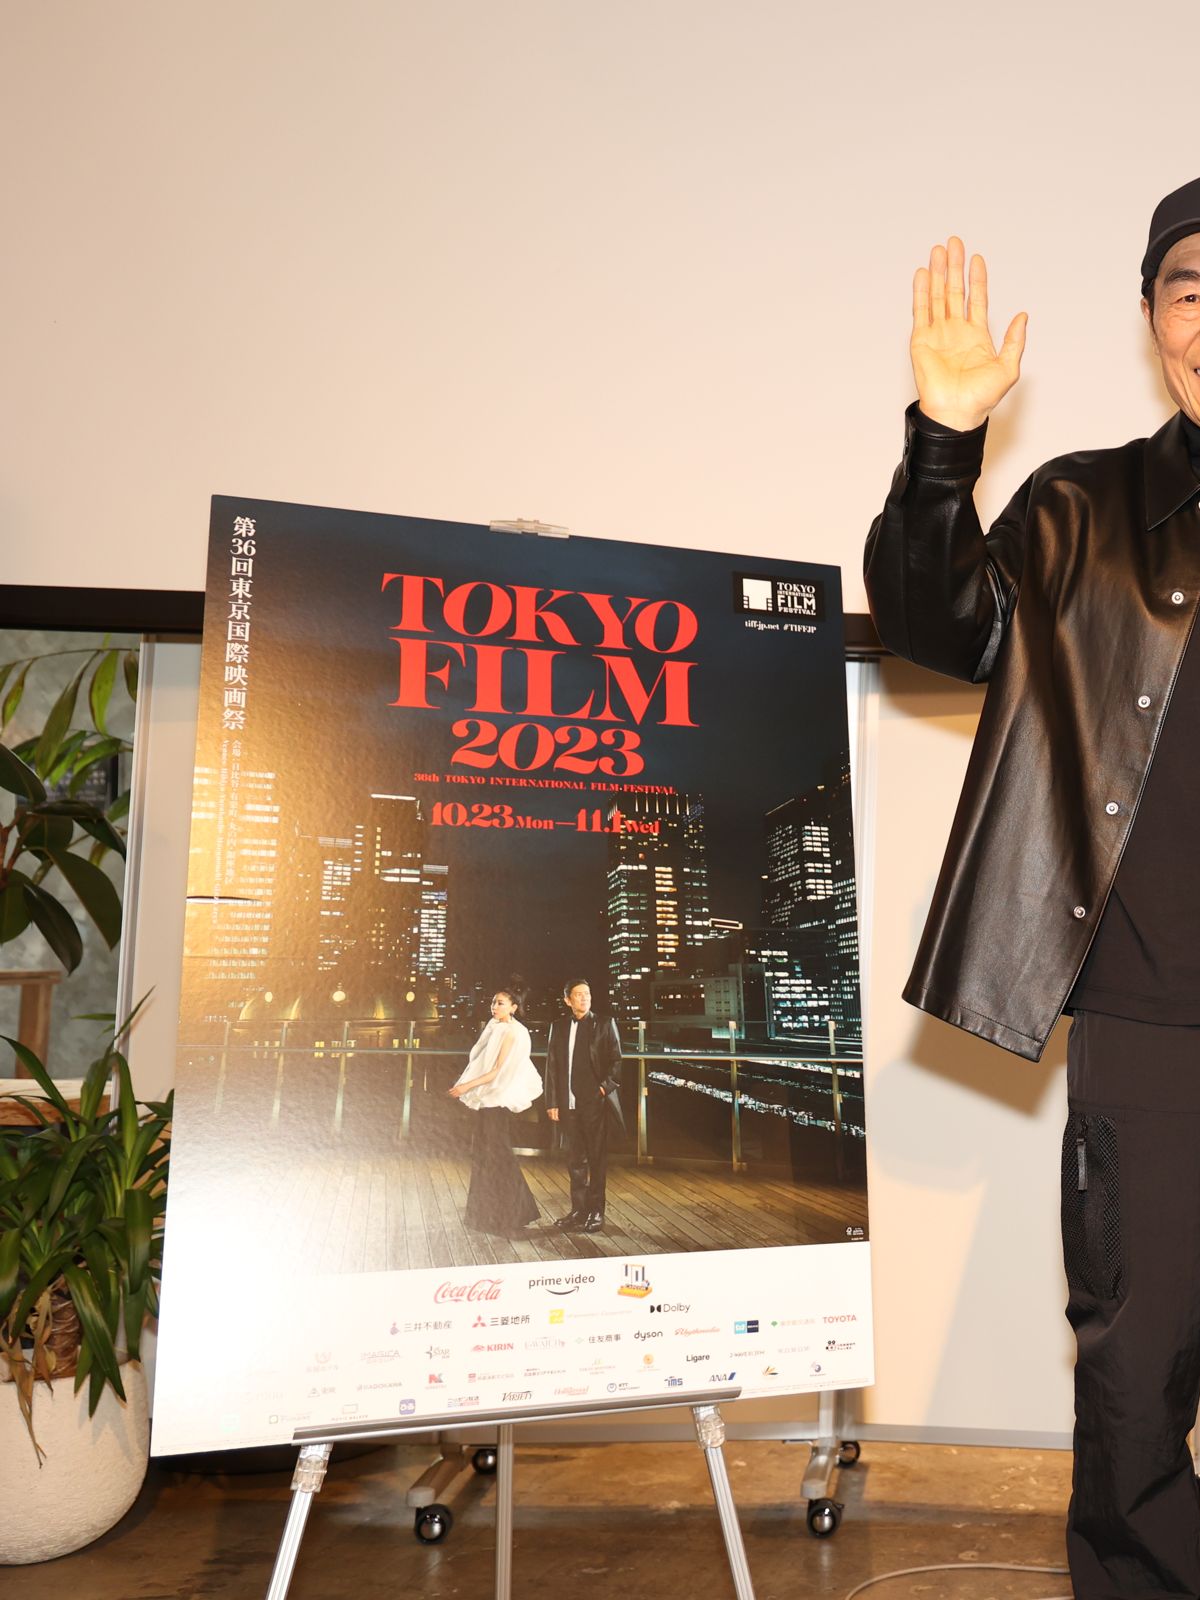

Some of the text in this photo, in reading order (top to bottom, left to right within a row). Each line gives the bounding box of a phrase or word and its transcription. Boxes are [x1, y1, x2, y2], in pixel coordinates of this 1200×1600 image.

[777, 582, 816, 594] TOKYO
[777, 594, 816, 611] FILM
[381, 572, 698, 654] TOKYO
[778, 606, 817, 616] FESTIVAL
[222, 516, 257, 730] 第36回東京国際映画祭
[744, 620, 817, 634] tiff-jp.net #TIFFJP
[387, 636, 699, 728] FILM
[451, 718, 645, 777] 2023
[413, 773, 678, 795] 36th TOKYO INTERNATIONAL FILM FESTIVAL
[528, 1274, 596, 1290] prime video
[662, 1303, 691, 1315] Dolby
[489, 1315, 531, 1327] 三菱地所
[822, 1315, 858, 1325] TOYOTA
[404, 1320, 453, 1333] 三井不動産
[588, 1334, 622, 1344] 住友商事
[633, 1330, 664, 1341] dyson
[486, 1342, 515, 1352] KIRIN
[686, 1354, 711, 1363] Ligare
